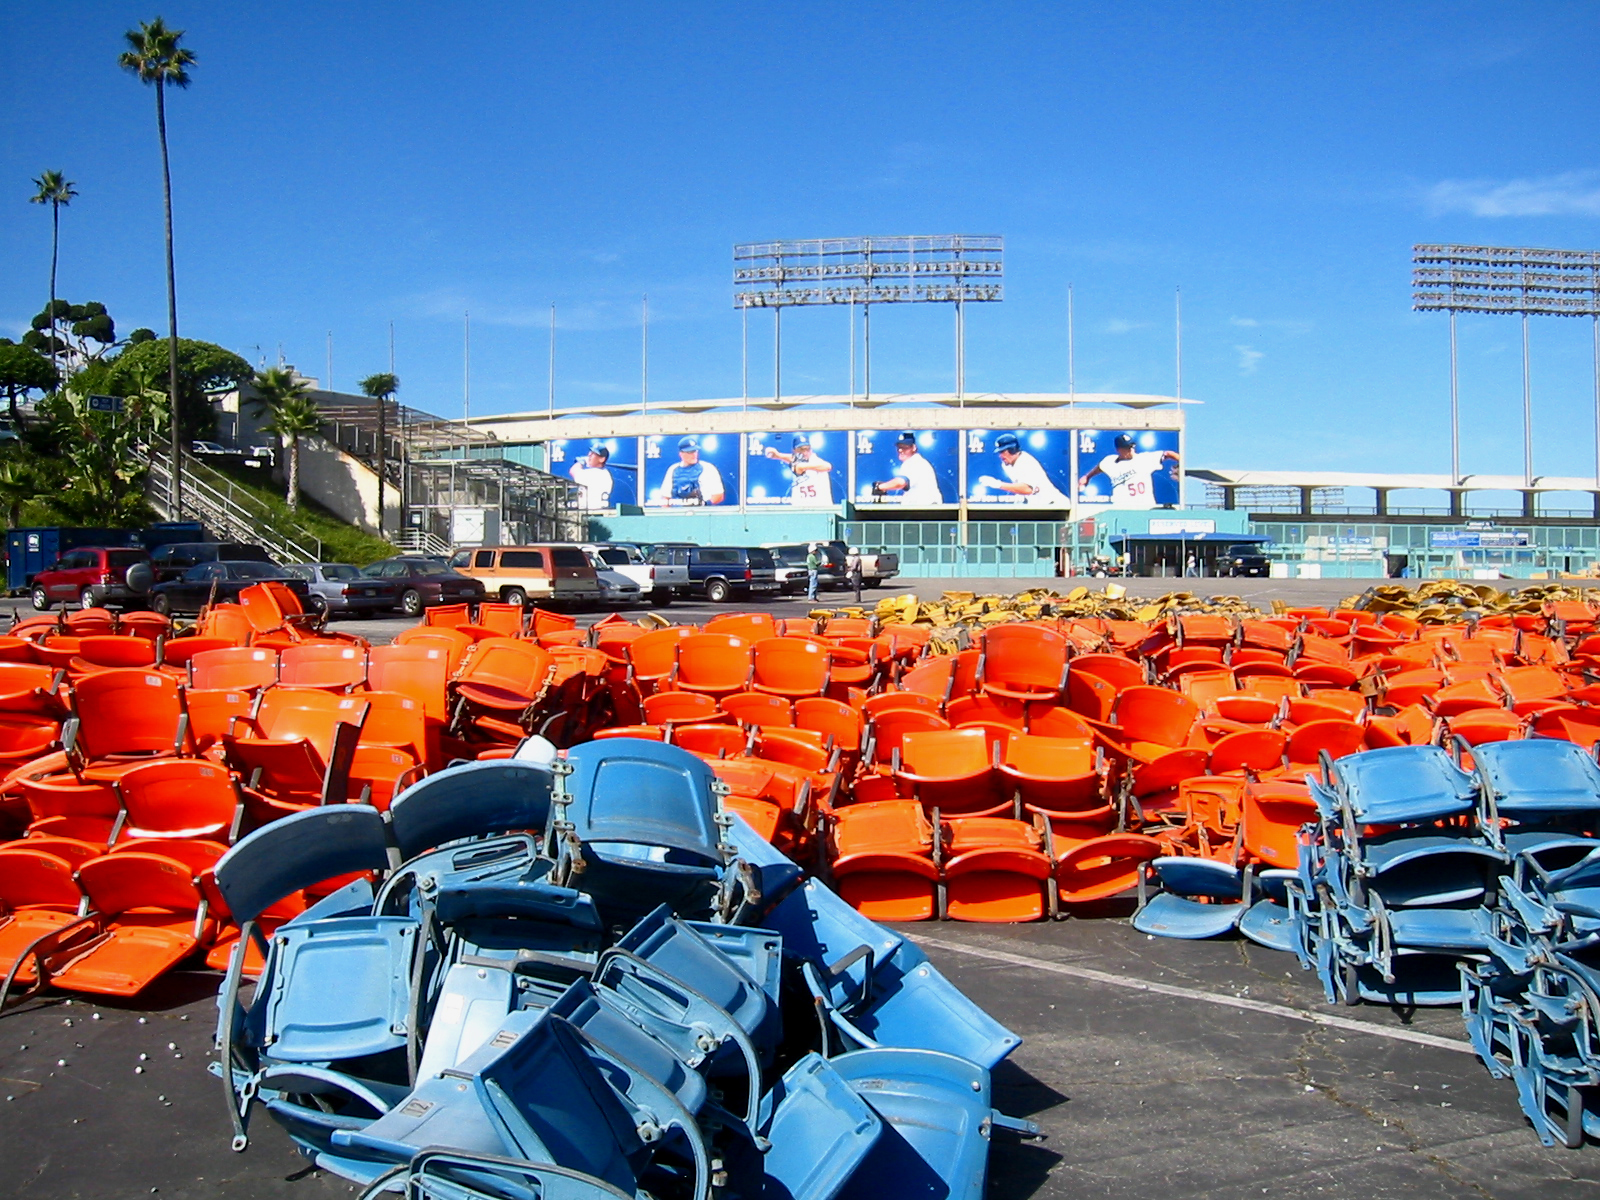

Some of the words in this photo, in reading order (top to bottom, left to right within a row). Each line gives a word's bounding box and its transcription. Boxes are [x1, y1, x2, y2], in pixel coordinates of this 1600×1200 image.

[646, 438, 661, 459] LA
[748, 434, 764, 456] LA
[857, 433, 873, 454] LA
[968, 431, 984, 453] LA
[1079, 432, 1096, 453] LA
[799, 484, 817, 498] 55
[1127, 481, 1146, 497] 50
